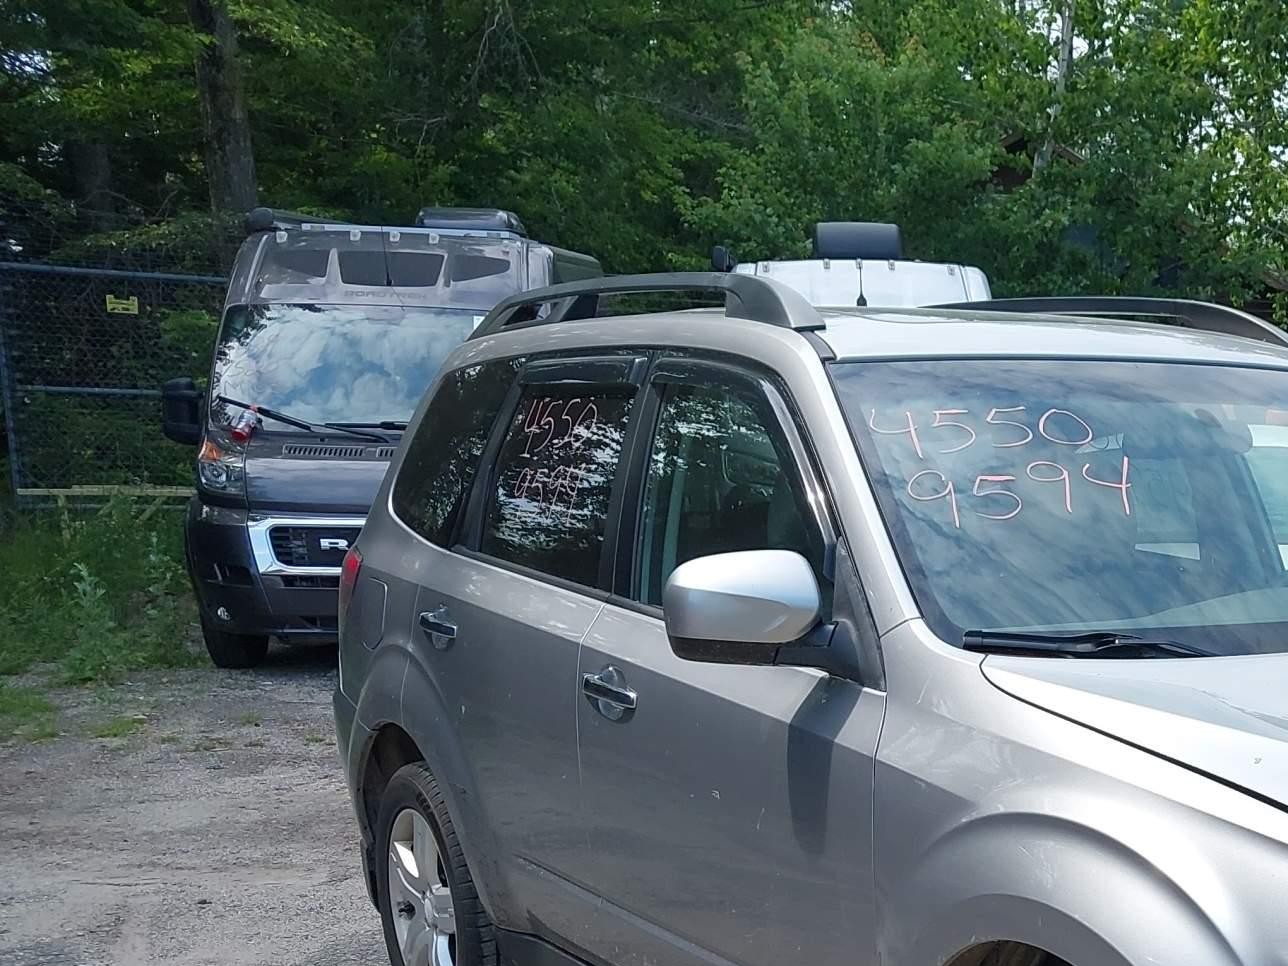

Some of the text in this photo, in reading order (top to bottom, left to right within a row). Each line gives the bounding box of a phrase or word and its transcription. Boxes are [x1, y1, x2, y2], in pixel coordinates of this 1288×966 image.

[522, 398, 599, 457] 4550
[870, 405, 1094, 459] 4550
[908, 455, 1132, 529] 9594
